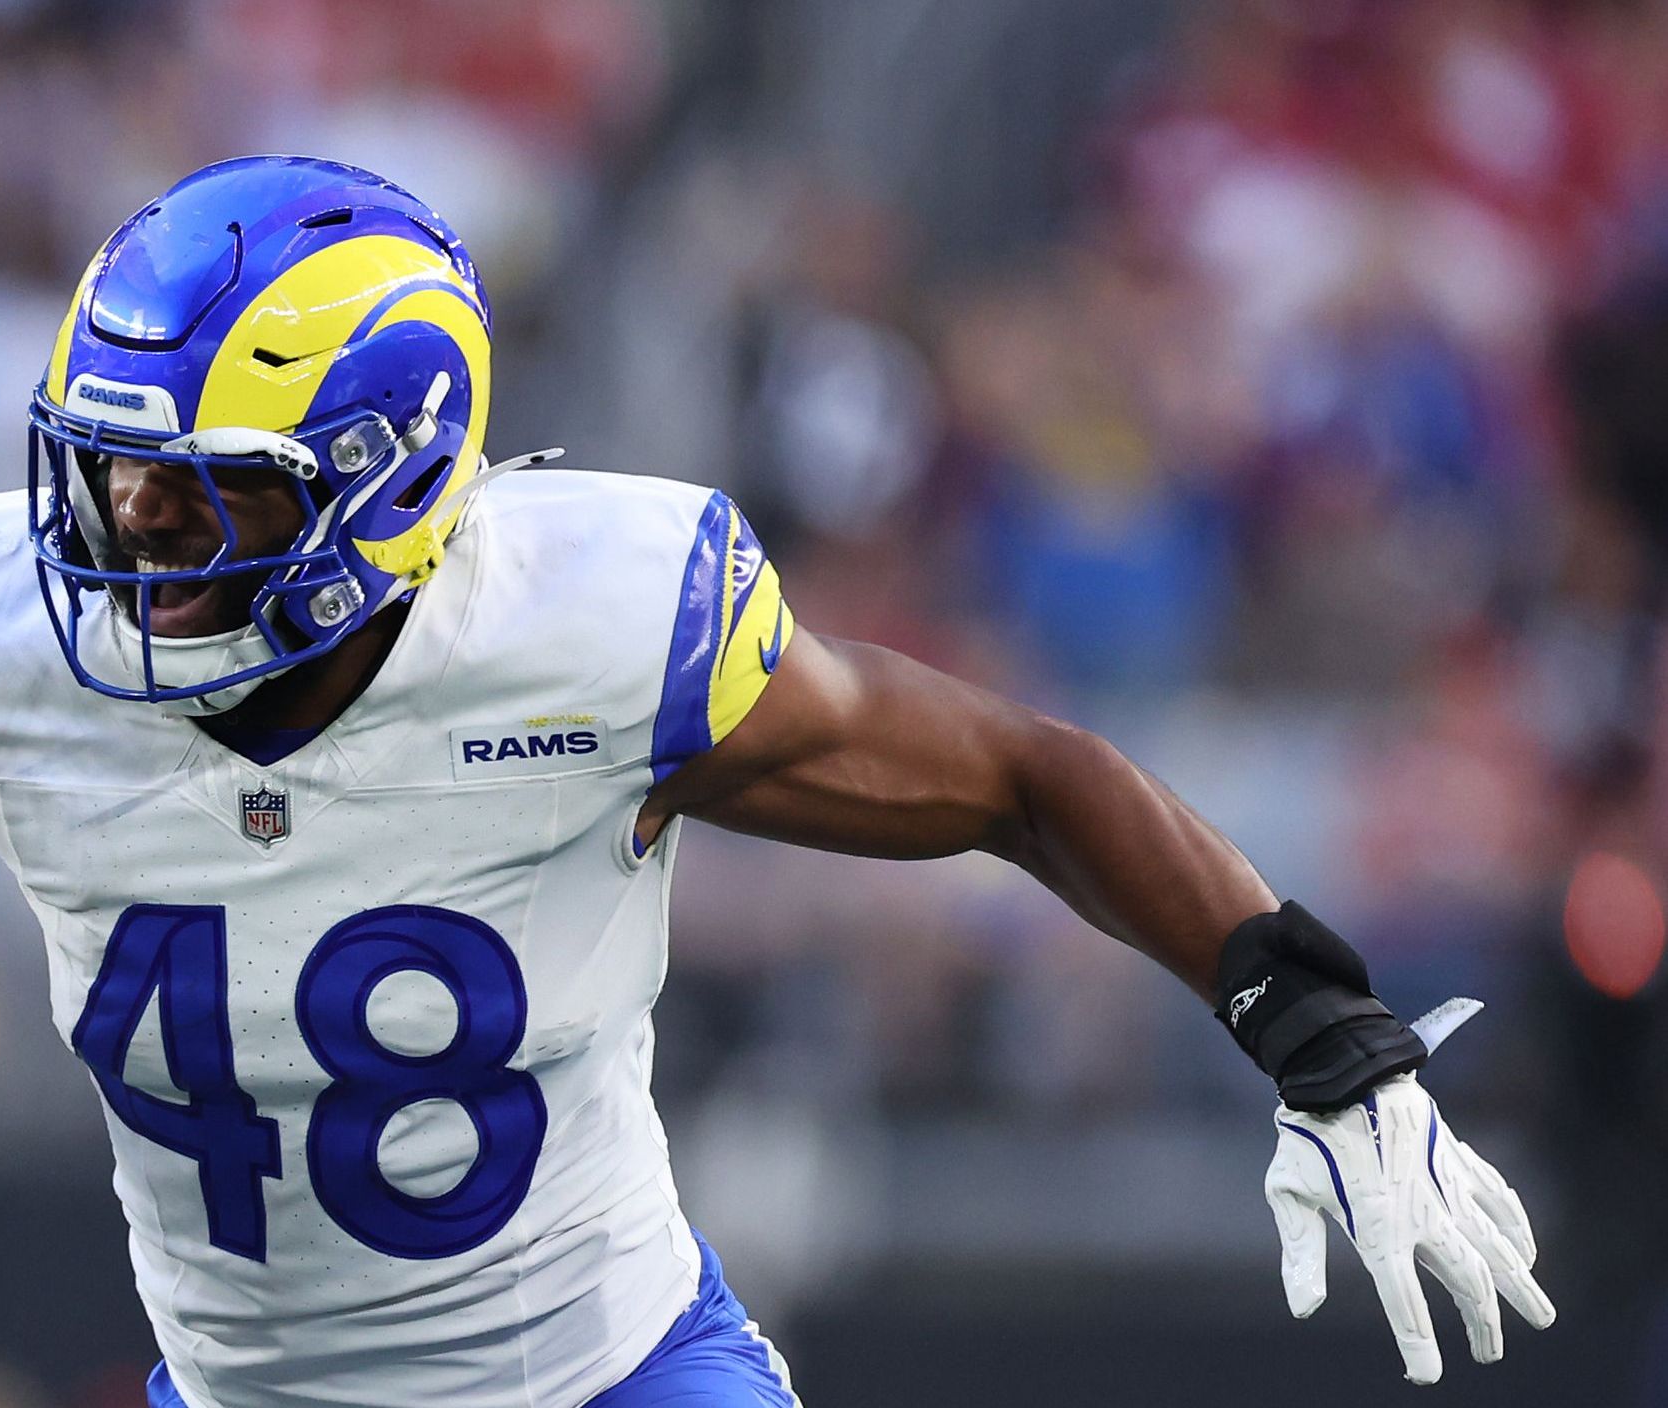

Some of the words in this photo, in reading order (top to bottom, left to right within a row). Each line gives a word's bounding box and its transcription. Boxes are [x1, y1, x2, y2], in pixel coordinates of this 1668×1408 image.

[78, 382, 146, 411] RAMS
[462, 731, 599, 764] RAMS
[246, 811, 283, 835] NFL
[72, 902, 549, 1263] 48
